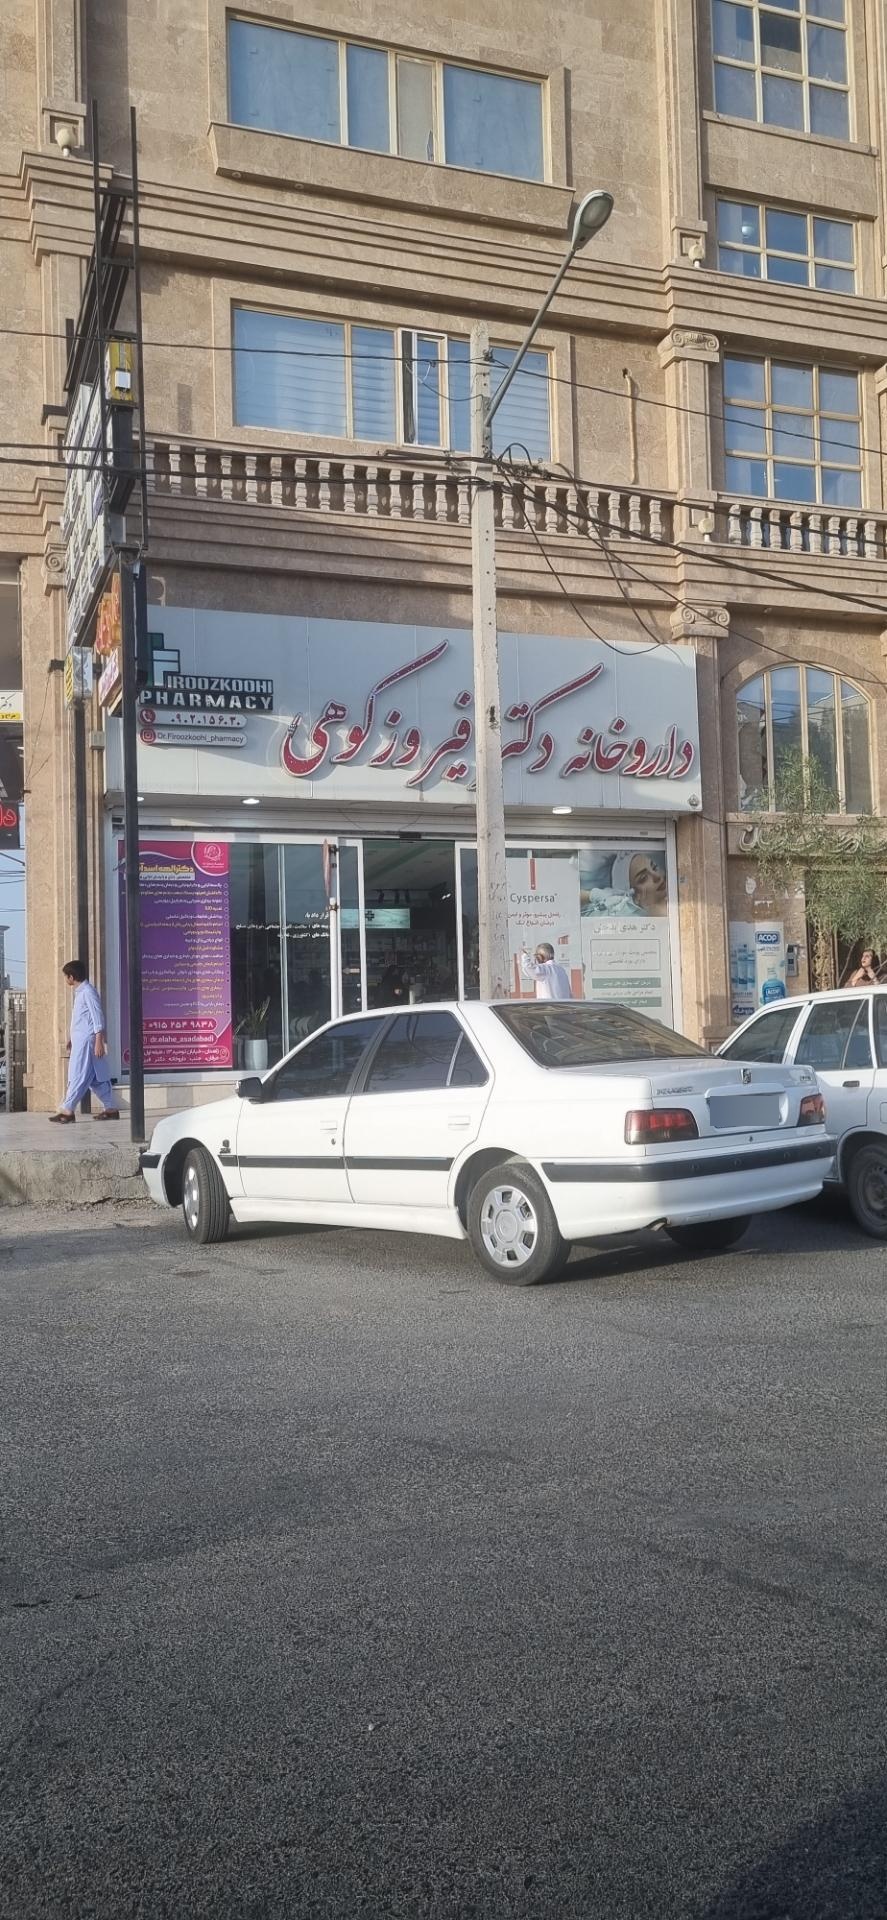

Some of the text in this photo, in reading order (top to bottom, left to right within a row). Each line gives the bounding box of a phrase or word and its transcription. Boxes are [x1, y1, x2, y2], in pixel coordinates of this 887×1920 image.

[140, 690, 273, 710] PHARMACY
[468, 662, 605, 790] دکت
[157, 732, 244, 744] Dr.Firoozkoohi_pharmacy
[561, 714, 695, 781] داروخانه
[510, 893, 555, 904] Cyspersa
[639, 923, 656, 934] دکتر
[758, 934, 777, 943] ACOP
